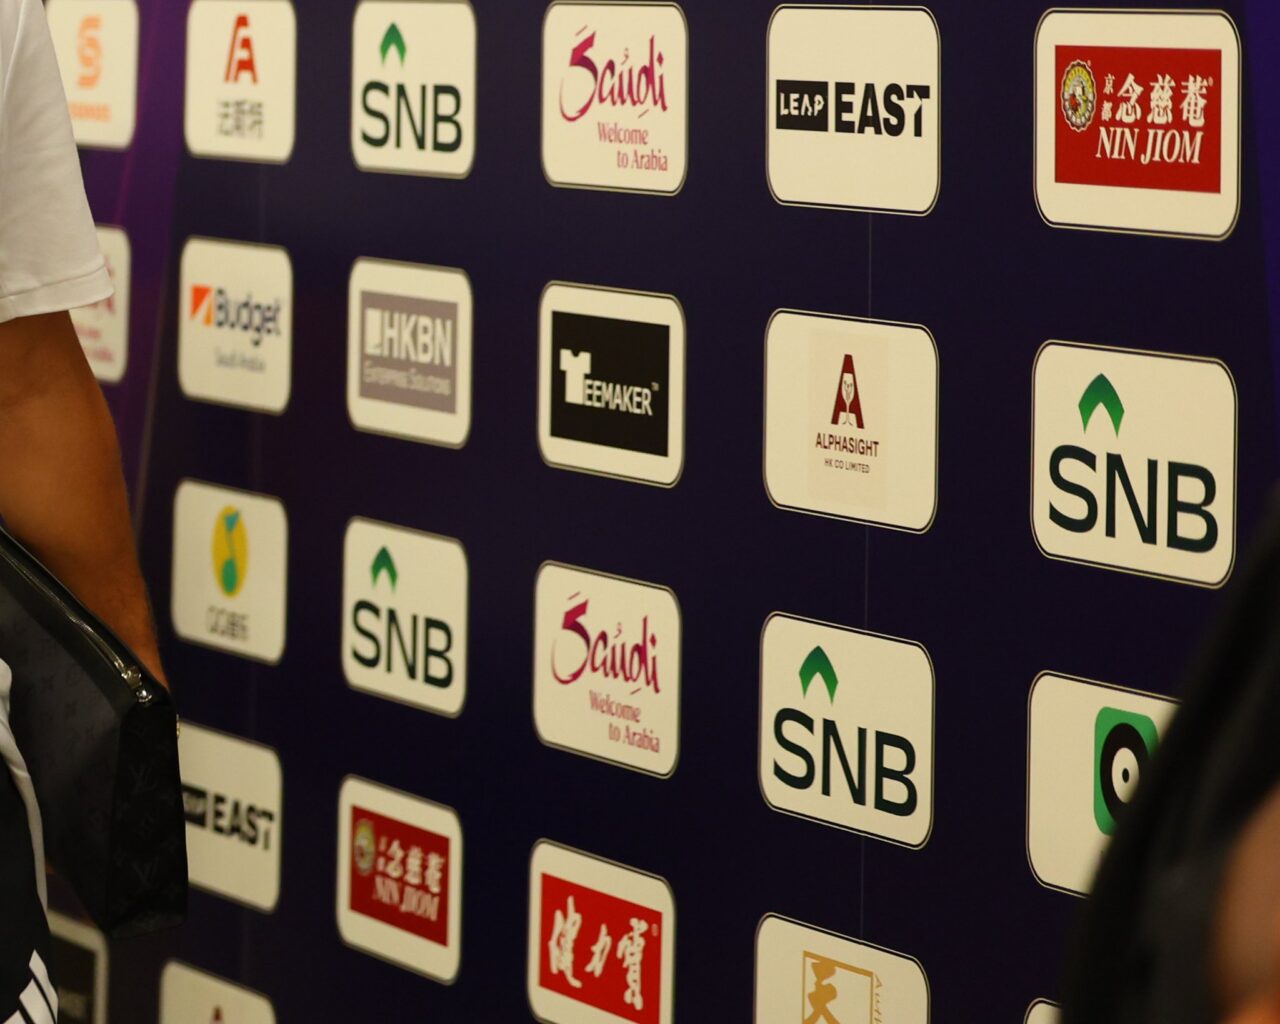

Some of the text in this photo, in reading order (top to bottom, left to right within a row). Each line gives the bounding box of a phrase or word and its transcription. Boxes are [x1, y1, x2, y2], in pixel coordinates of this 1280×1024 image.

[559, 29, 668, 122] Saudi
[362, 81, 463, 153] SNB
[597, 122, 648, 145] Welcome
[780, 83, 930, 137] LEAP EAST
[617, 149, 668, 171] to Arabia
[1095, 126, 1204, 165] NIN JIOM
[215, 287, 281, 348] Budget
[383, 309, 452, 367] HKBN
[815, 432, 879, 457] ALPHASIGHT
[824, 458, 871, 474] HK CO LIMITED
[1048, 444, 1219, 554] SNB
[352, 599, 453, 689] SNB
[551, 596, 660, 692] Saudi
[589, 690, 641, 723] Welcome
[608, 723, 660, 753] to Arabia
[772, 708, 918, 819] SNB
[213, 793, 274, 850] EAST
